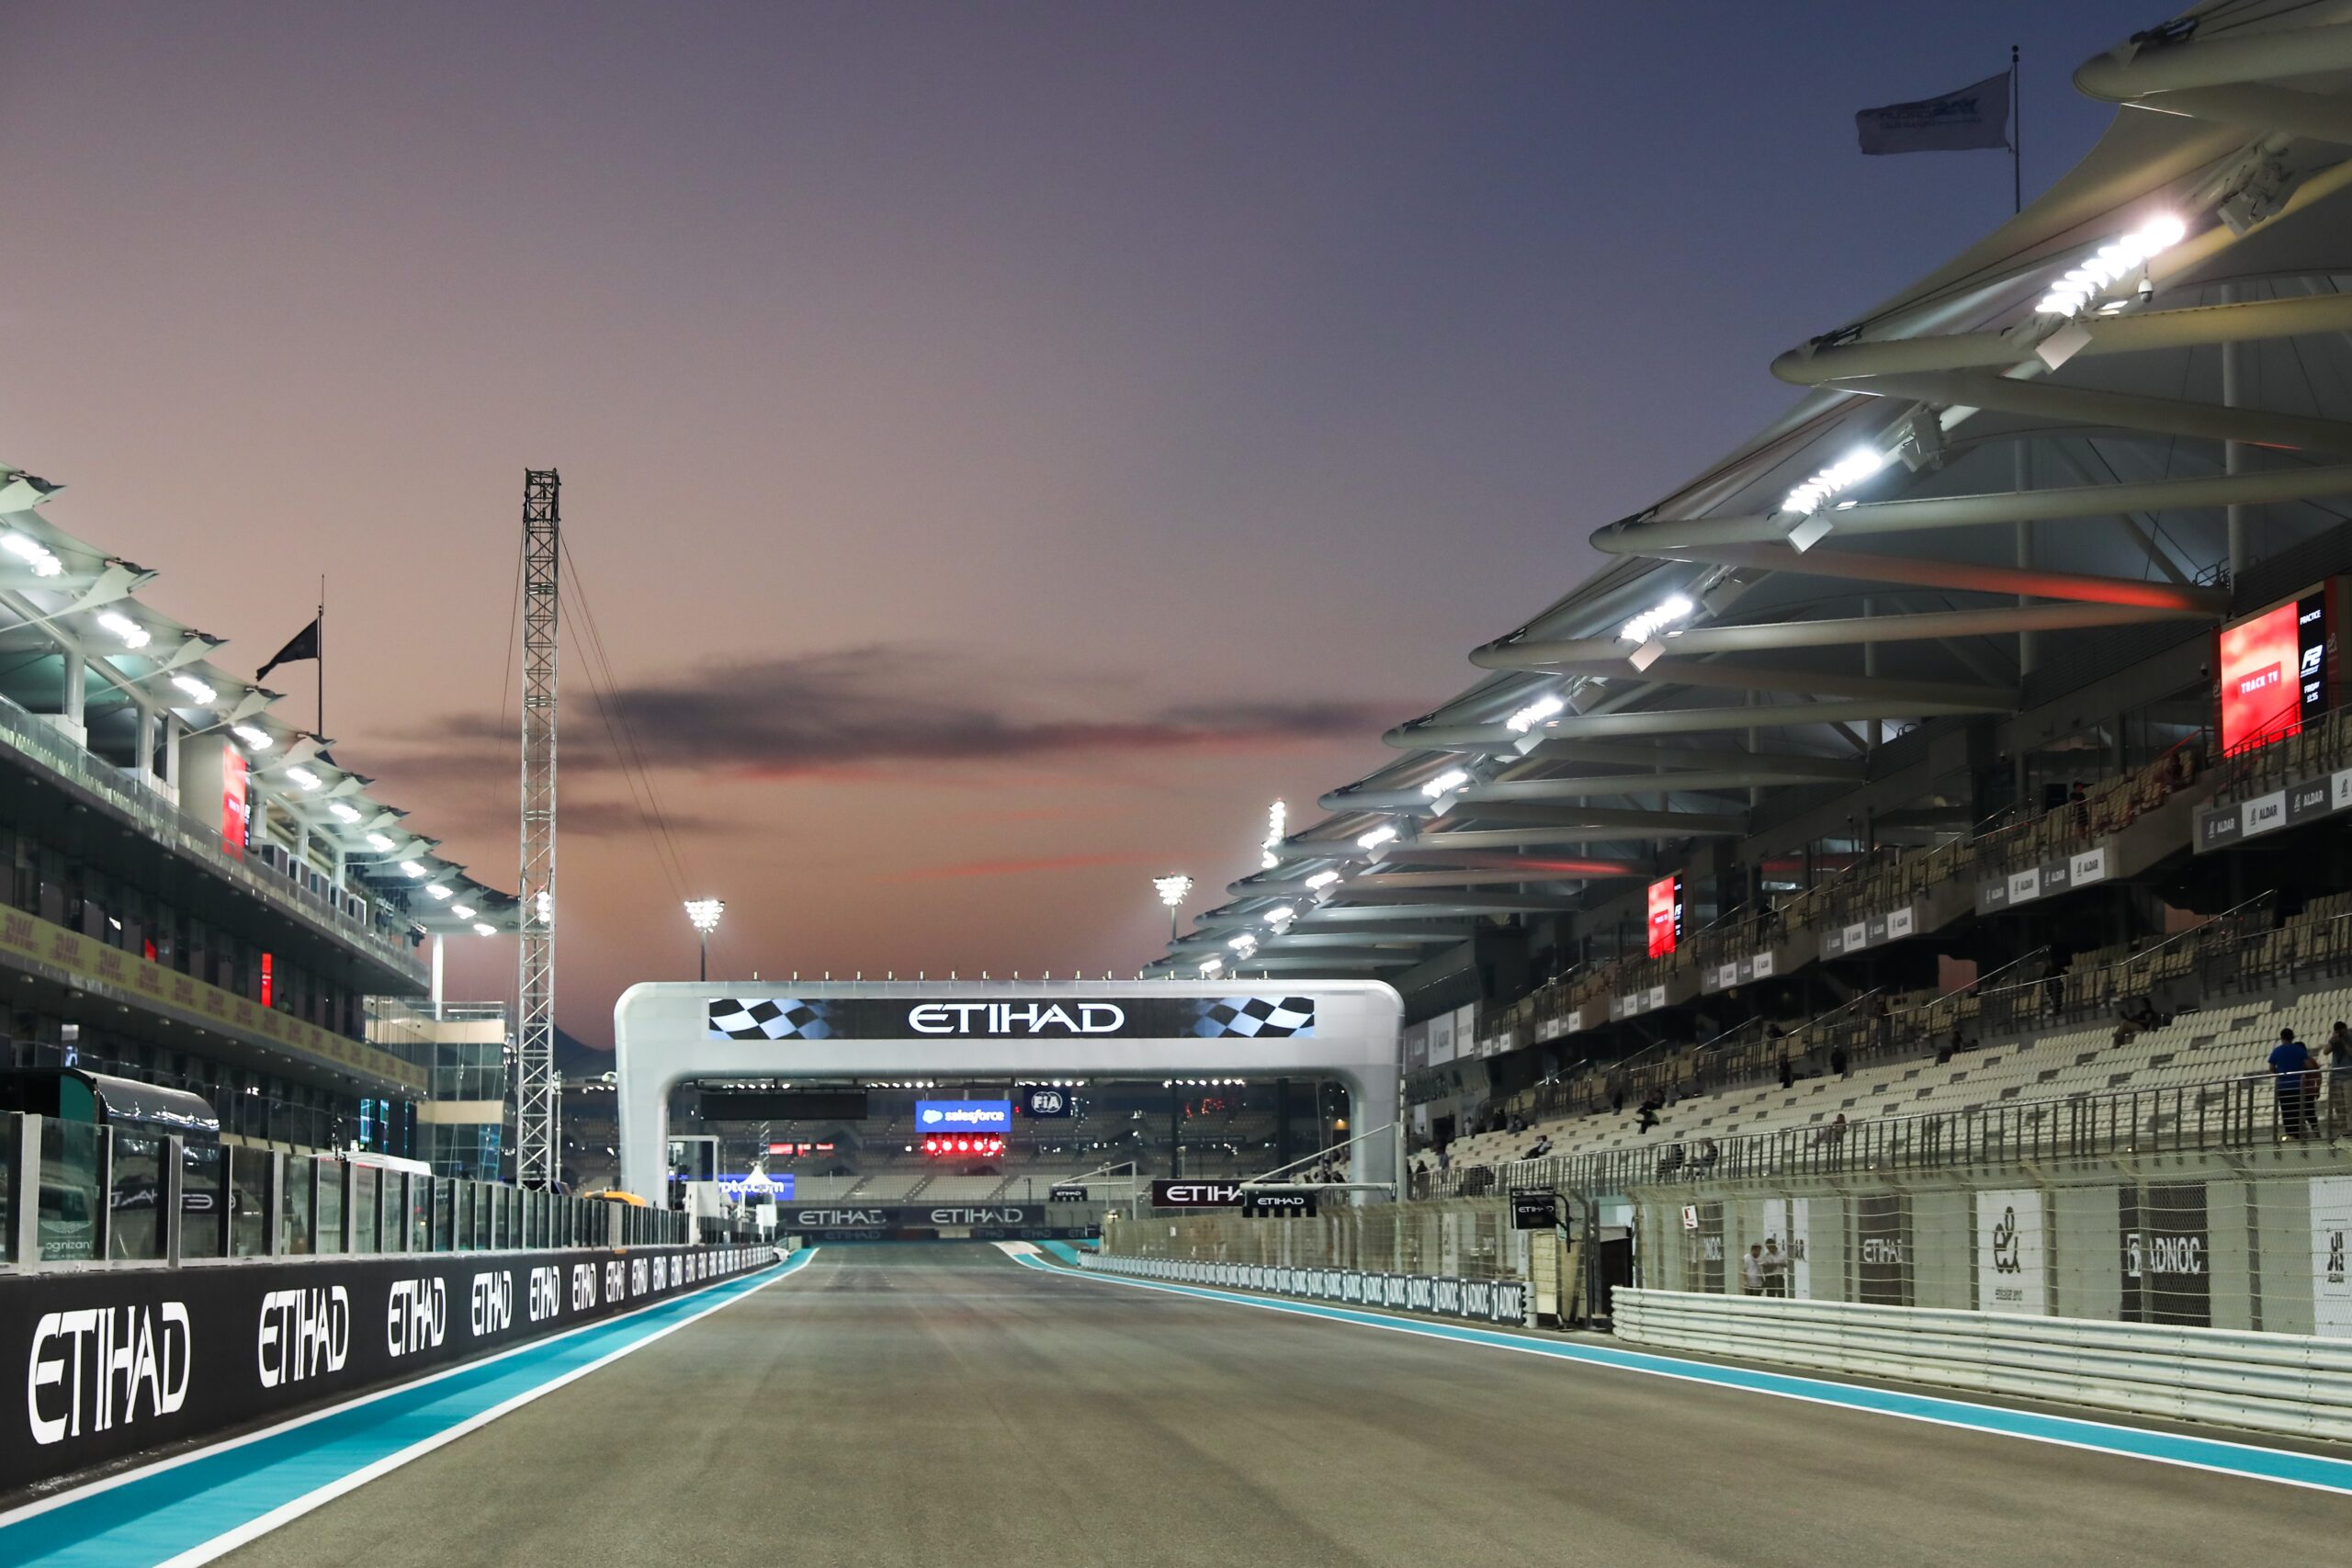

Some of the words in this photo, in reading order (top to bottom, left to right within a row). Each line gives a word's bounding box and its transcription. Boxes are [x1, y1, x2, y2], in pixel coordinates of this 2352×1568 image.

[2241, 676, 2266, 694] TRACK
[2267, 671, 2278, 684] TV
[2259, 805, 2278, 820] ALDAR
[2303, 790, 2324, 807] ALDAR
[909, 1003, 1125, 1033] ETIHAD
[944, 1109, 1004, 1124] salesforce
[931, 1209, 1023, 1224] ETIHAD
[471, 1270, 513, 1337] ETIHAD
[529, 1266, 560, 1322] ETIHAD
[572, 1263, 597, 1312] ETIHAD
[1498, 1286, 1521, 1319] ADNOC
[387, 1277, 447, 1358] ETIHAD
[258, 1285, 349, 1388] ETIHAD
[28, 1302, 191, 1445] ETIHAD
